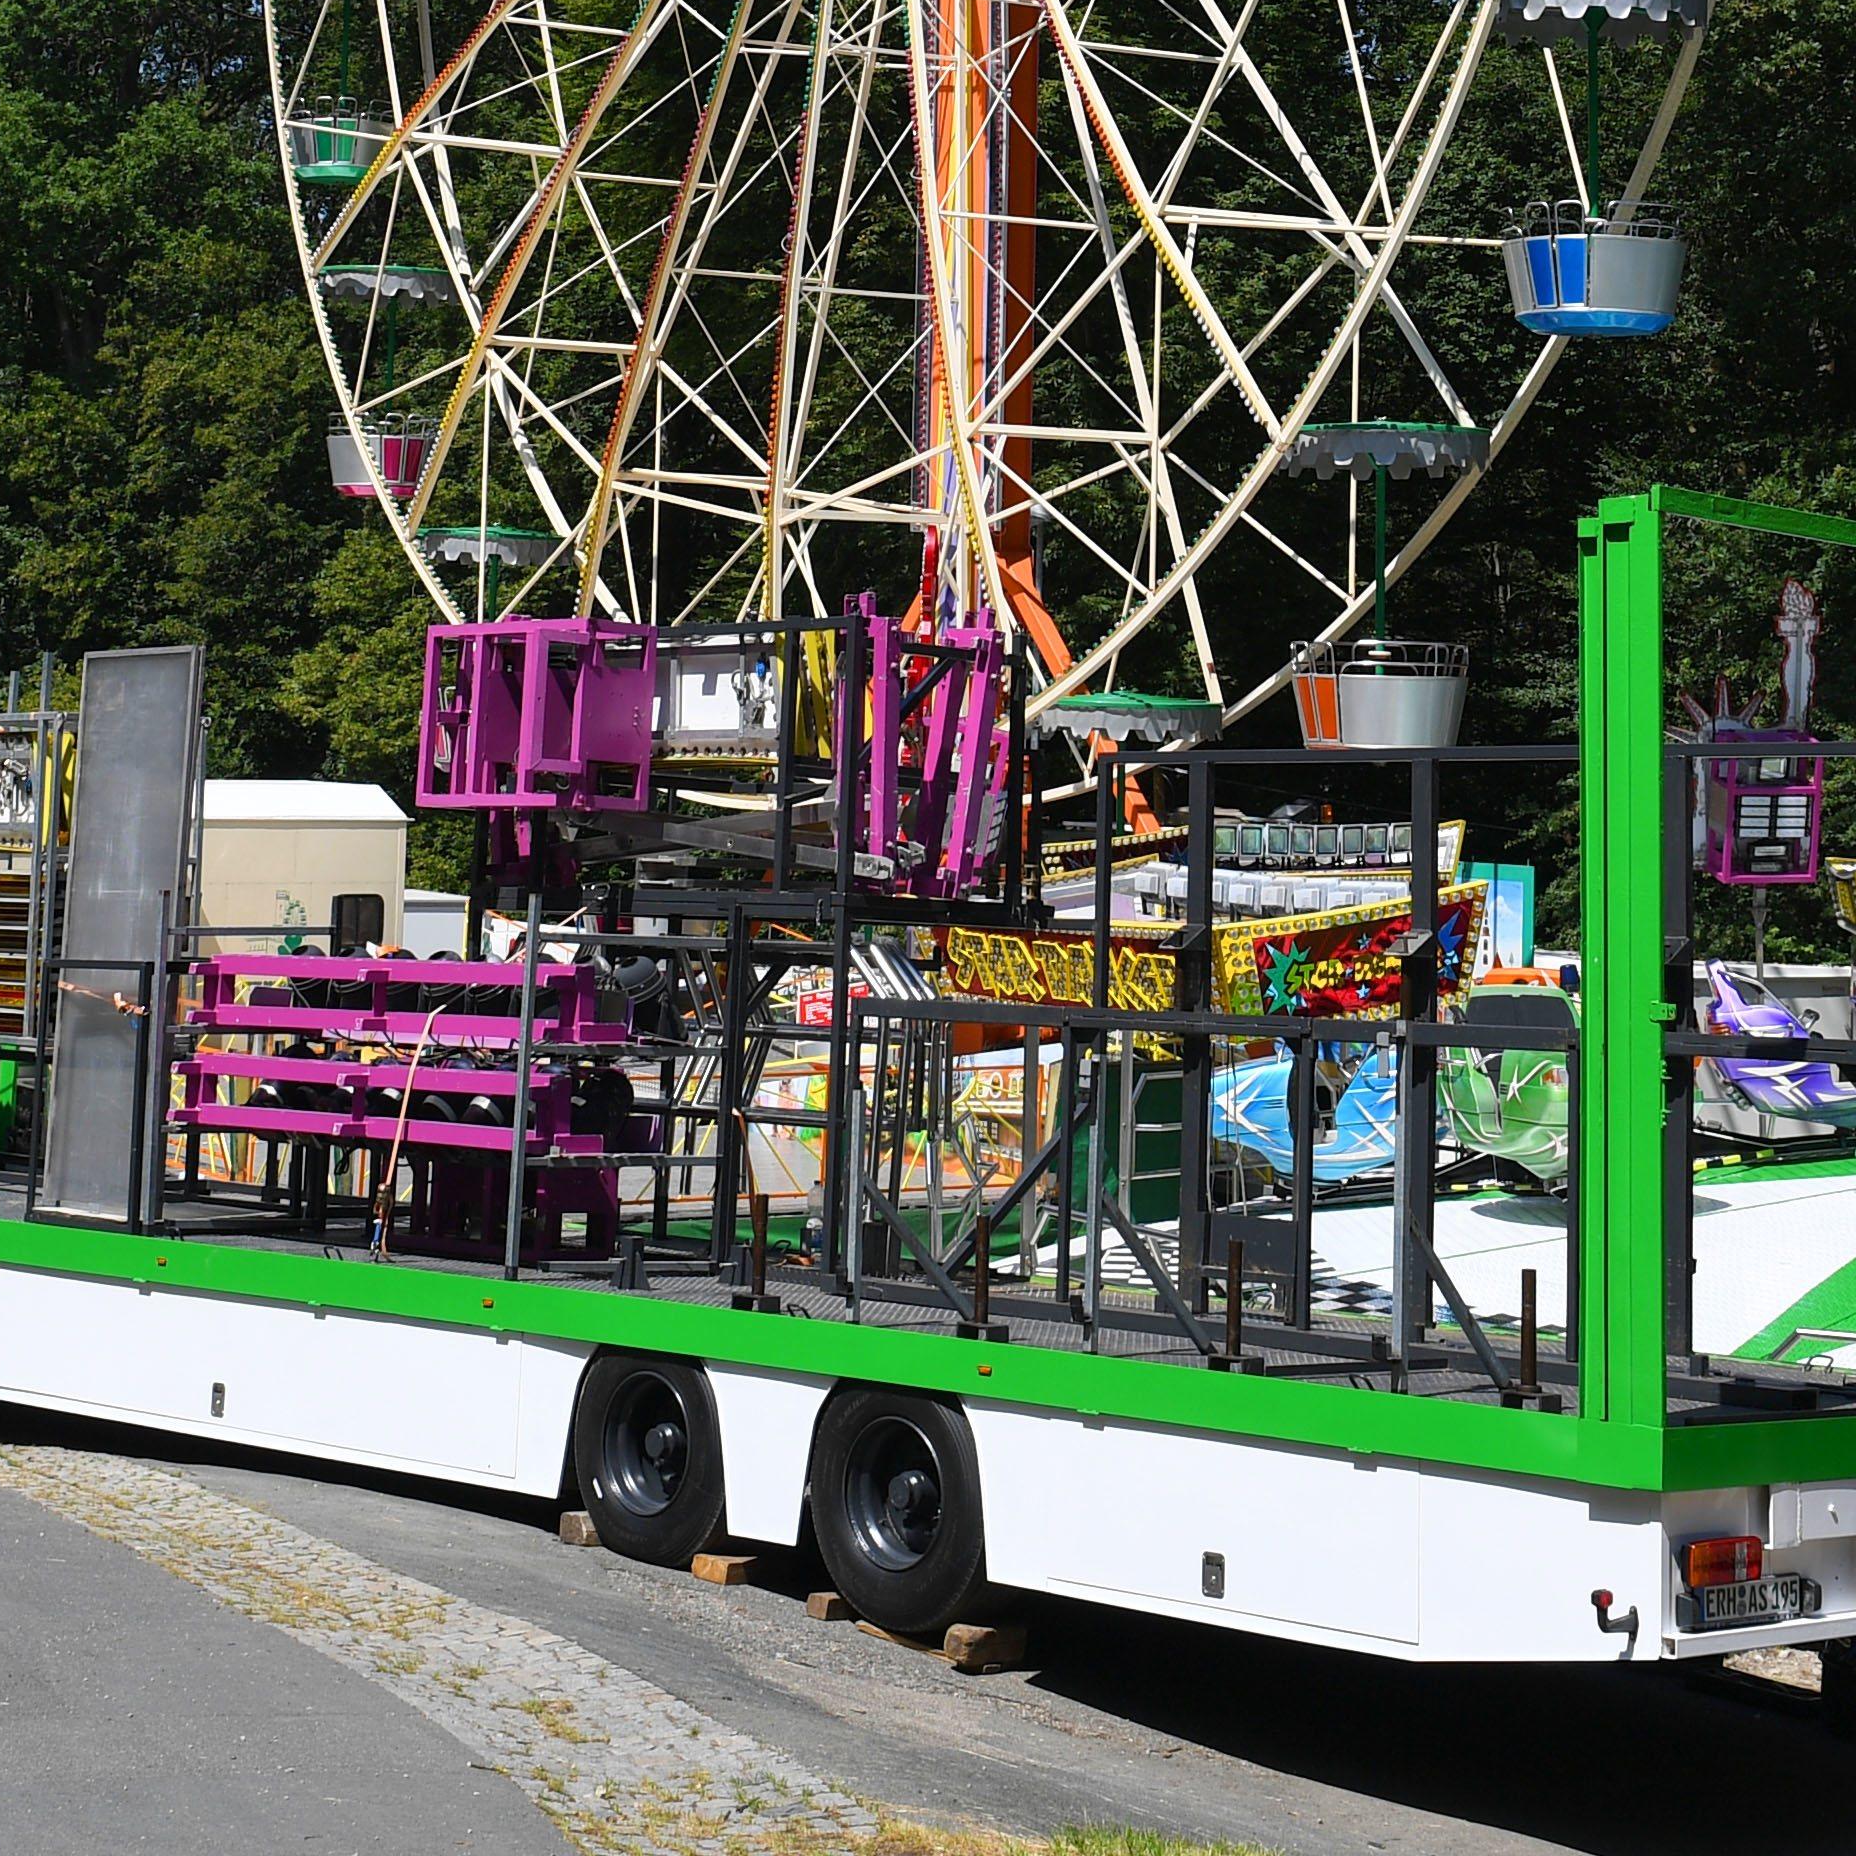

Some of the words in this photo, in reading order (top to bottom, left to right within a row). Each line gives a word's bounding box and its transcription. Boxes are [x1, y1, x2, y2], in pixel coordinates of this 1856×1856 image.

[1706, 1587, 1737, 1617] ERH
[1748, 1585, 1768, 1613] AS
[1771, 1580, 1799, 1610] 195
